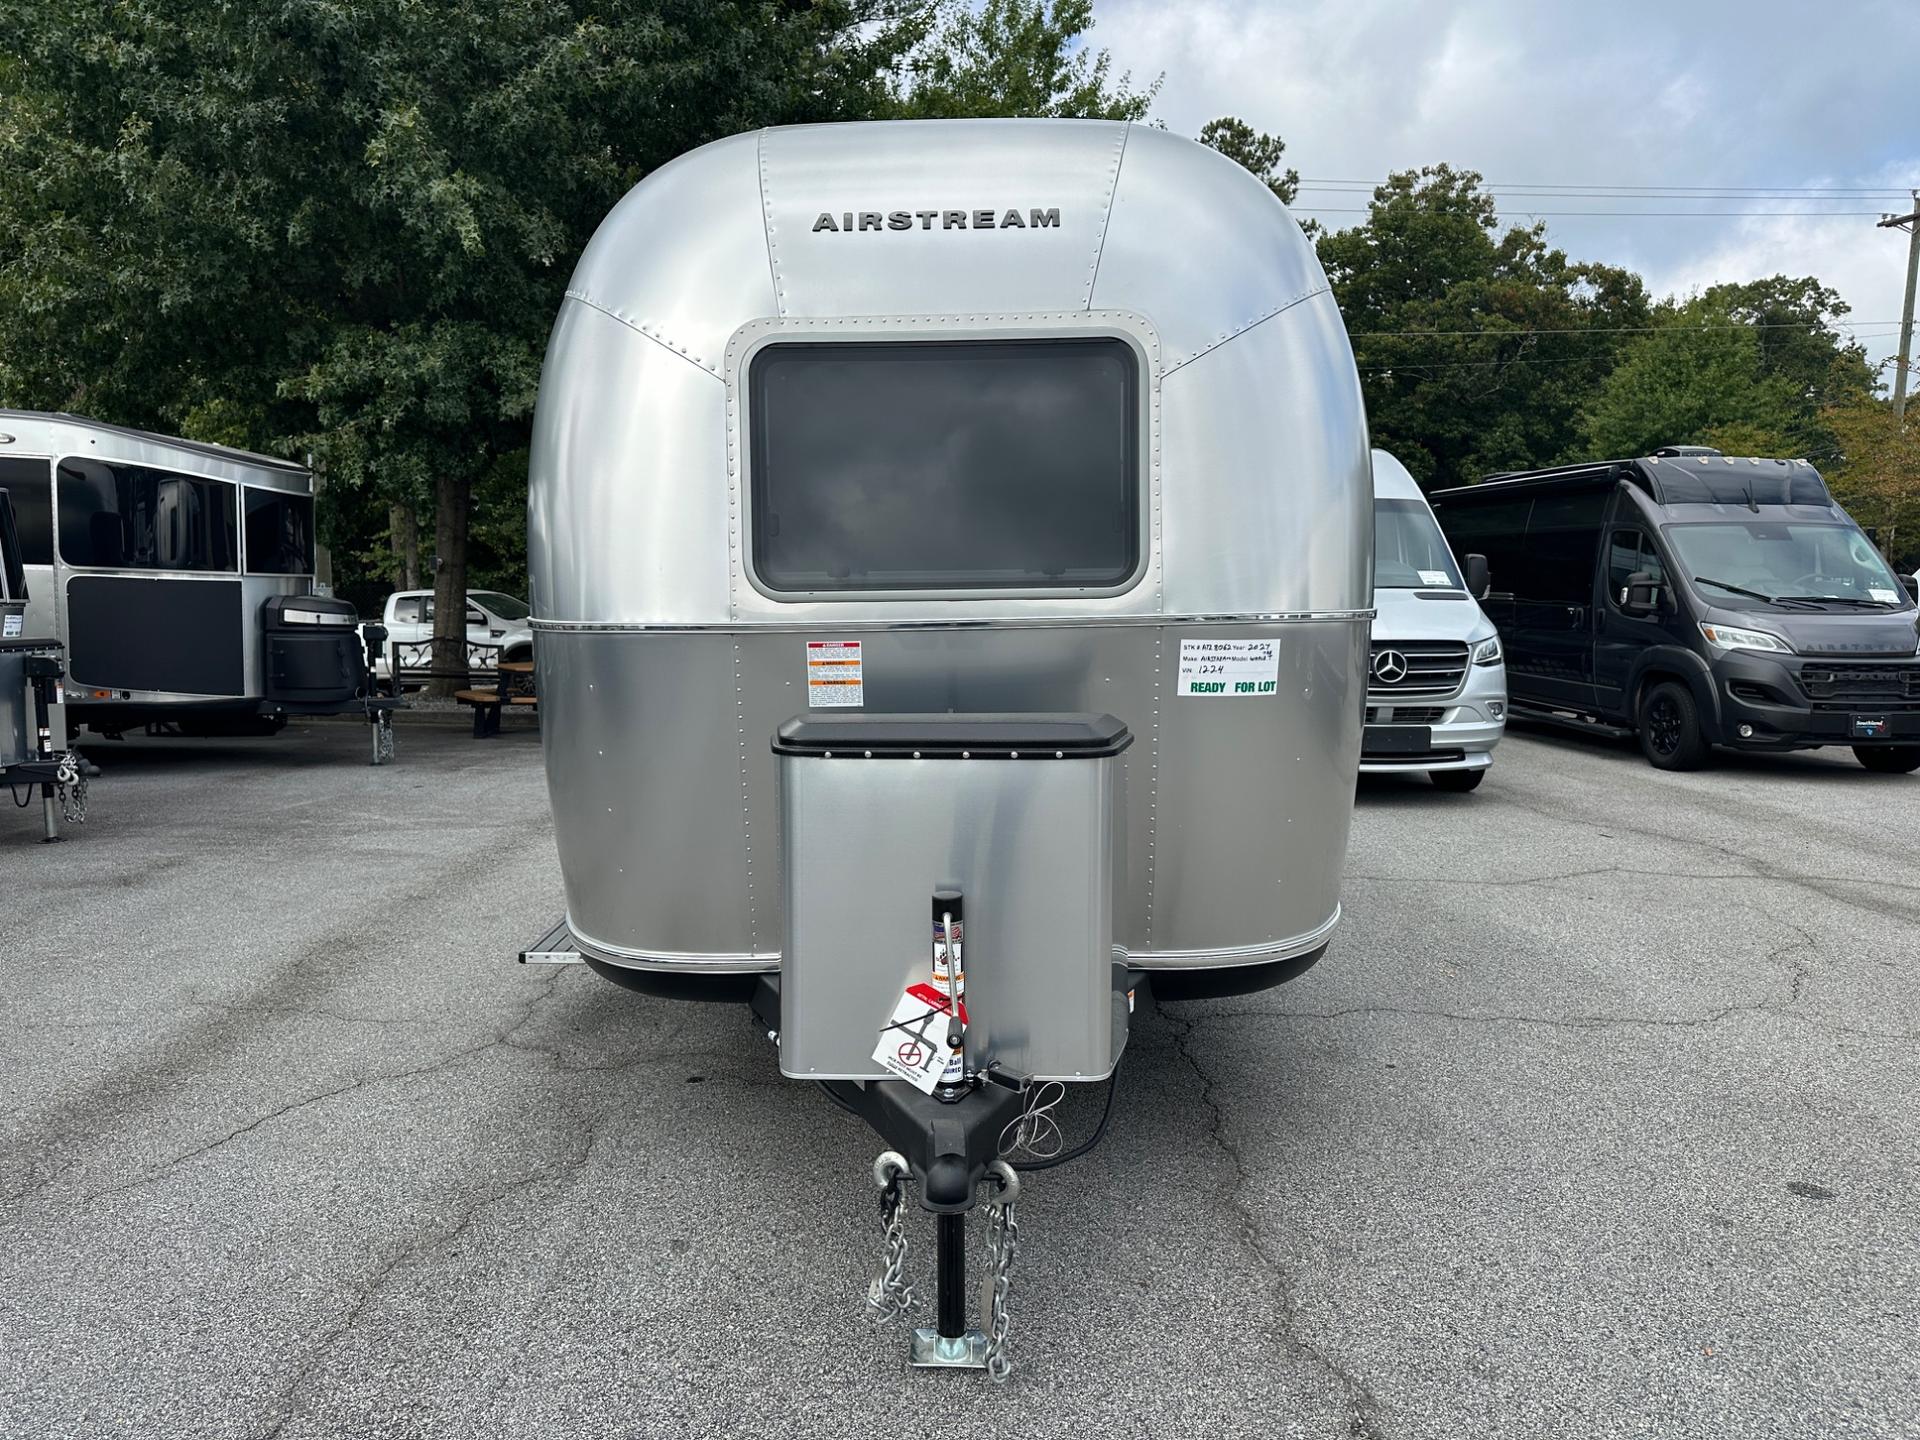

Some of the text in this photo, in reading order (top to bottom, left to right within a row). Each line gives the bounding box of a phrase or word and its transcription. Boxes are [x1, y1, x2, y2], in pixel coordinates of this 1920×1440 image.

[812, 208, 1060, 232] AIRSTREAM
[1190, 681, 1276, 692] READY FOR LOT
